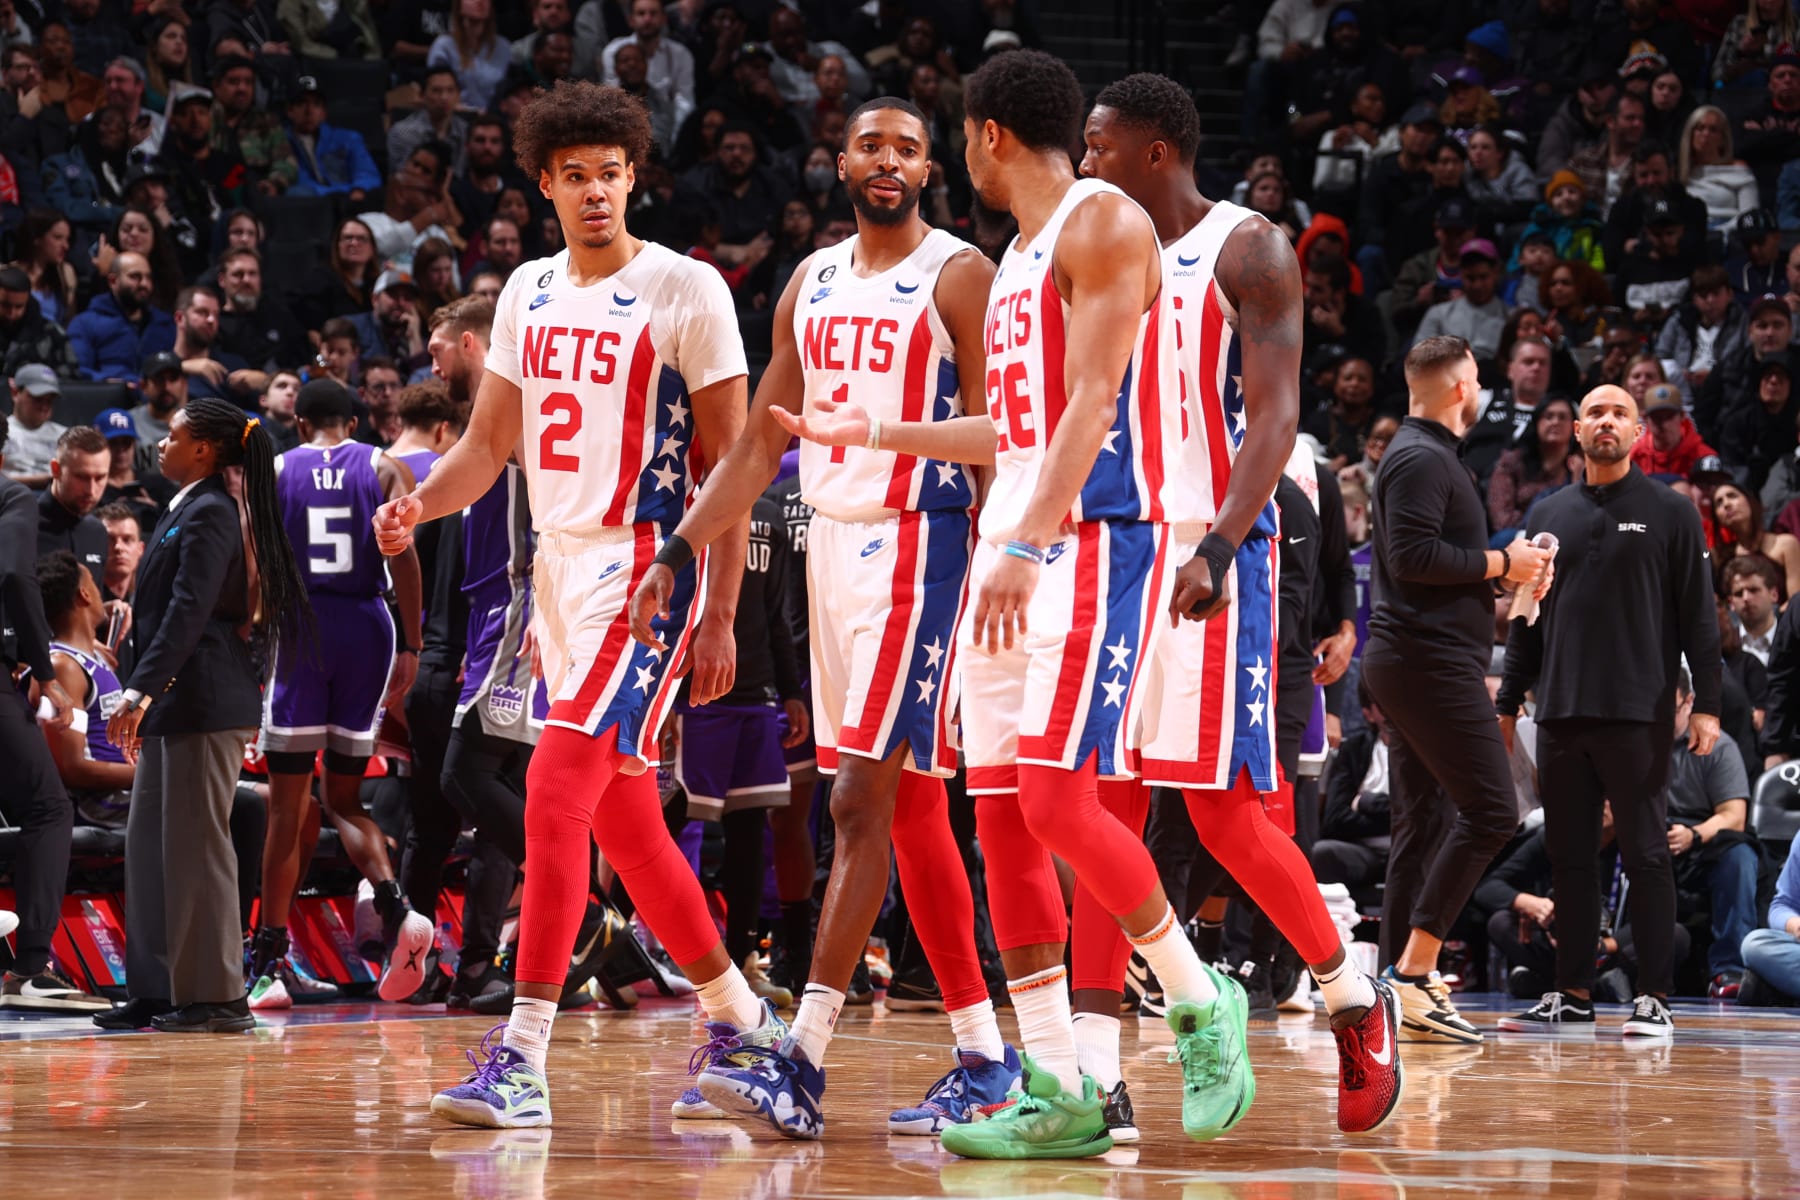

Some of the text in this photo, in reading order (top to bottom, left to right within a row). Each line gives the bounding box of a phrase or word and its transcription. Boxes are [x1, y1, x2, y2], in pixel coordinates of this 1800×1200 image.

[889, 296, 914, 305] Webull
[608, 308, 632, 318] Webull
[522, 325, 621, 385] NETS
[803, 316, 899, 373] NETS
[540, 392, 582, 473] 2
[311, 467, 346, 490] FOX
[1618, 523, 1647, 532] SAC
[307, 506, 353, 573] 5
[491, 697, 521, 712] SAC
